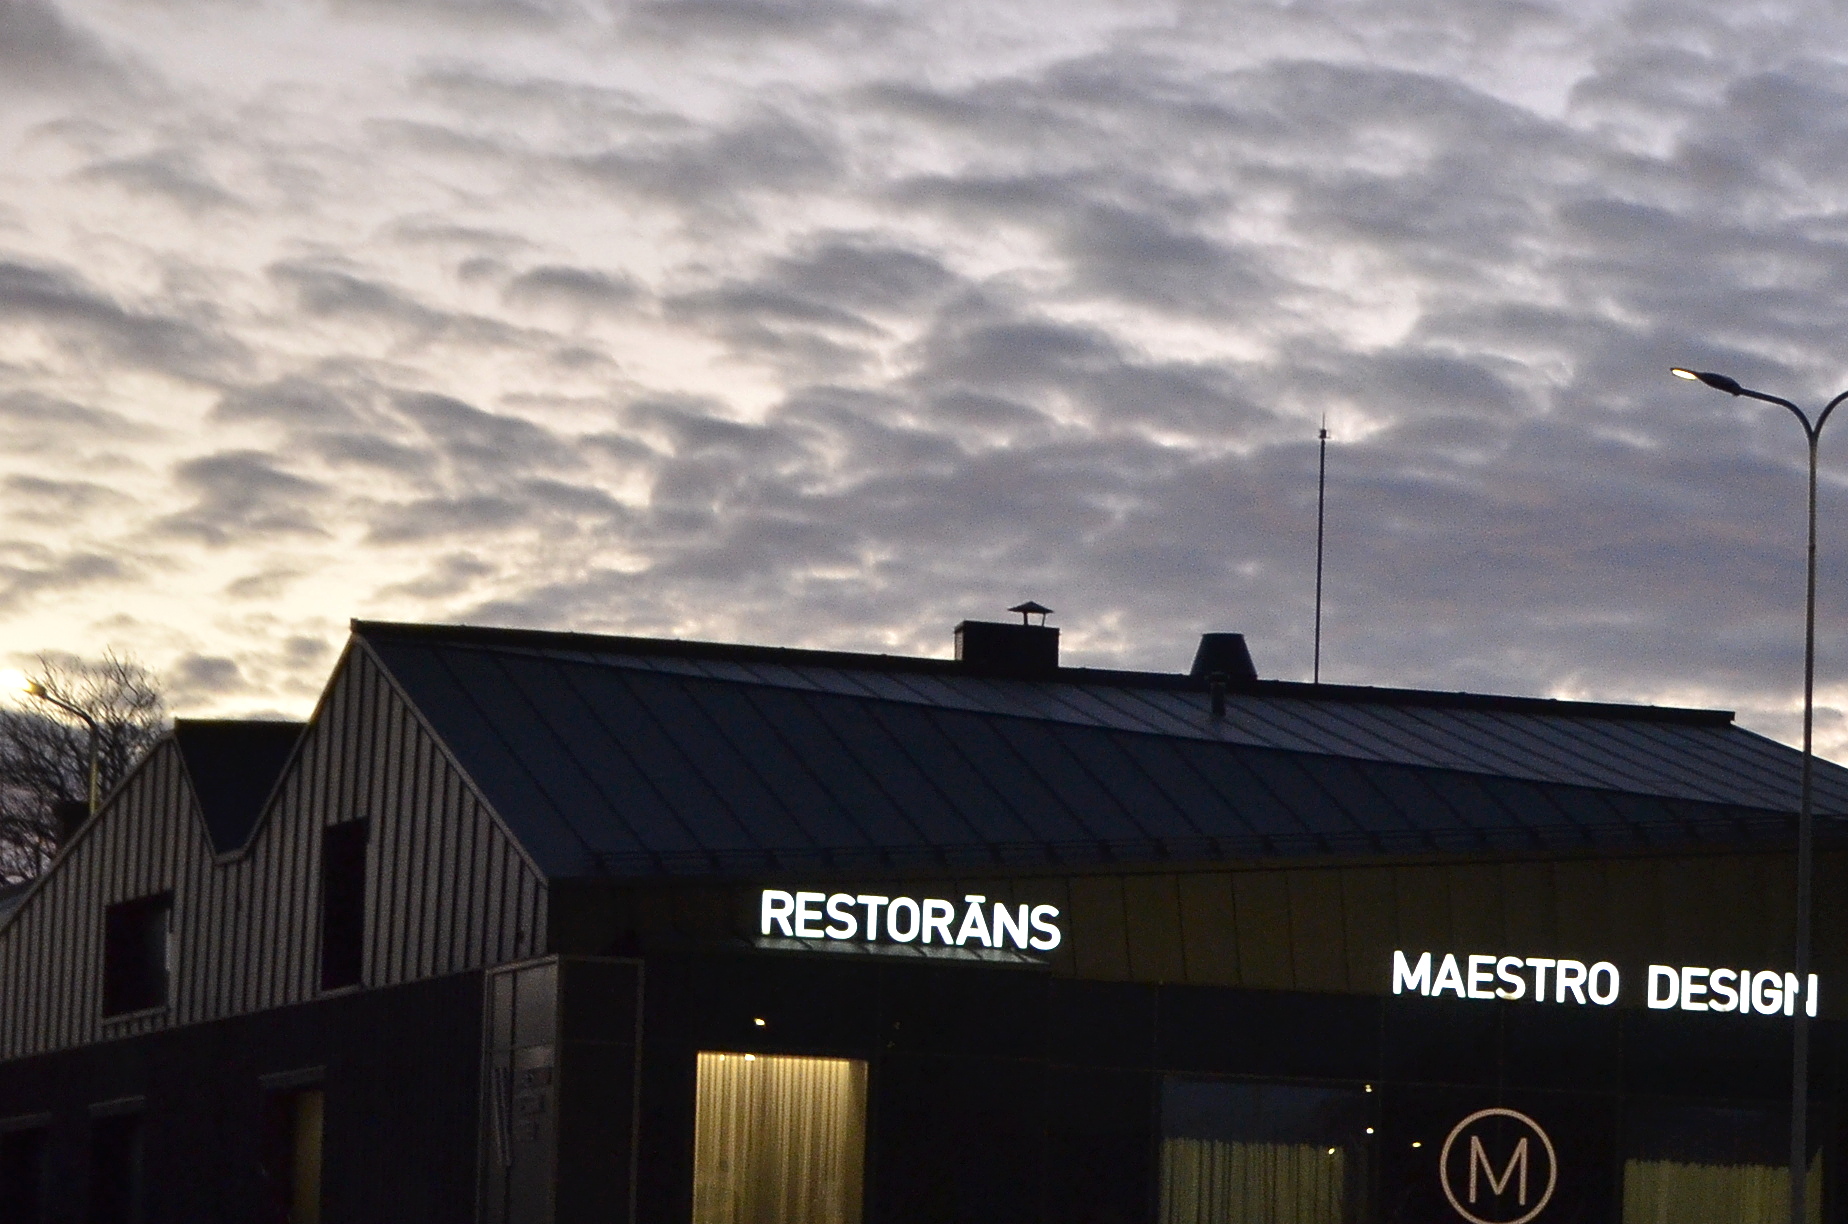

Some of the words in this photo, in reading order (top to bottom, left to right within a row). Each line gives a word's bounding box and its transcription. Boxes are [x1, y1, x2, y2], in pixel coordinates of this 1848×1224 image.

[761, 888, 1062, 951] RESTORĀNS
[1392, 950, 1620, 1006] MAESTRO
[1647, 964, 1818, 1018] DESIGN
